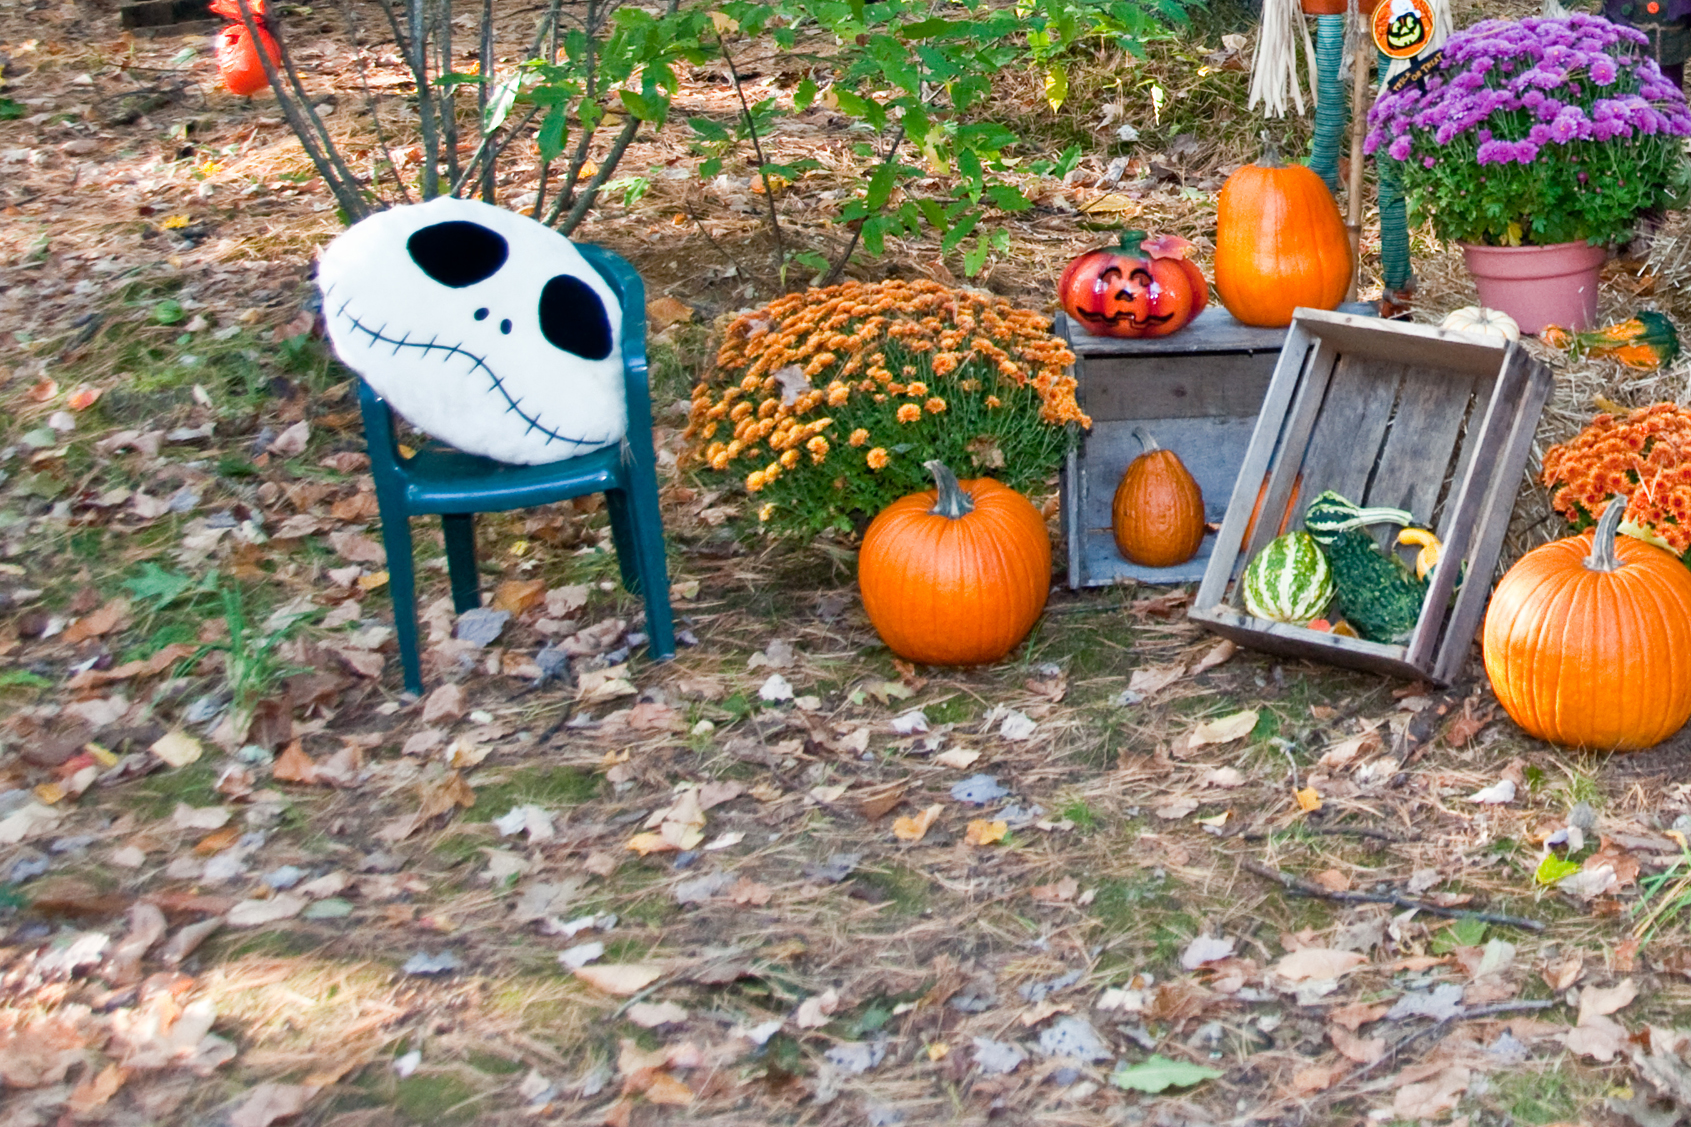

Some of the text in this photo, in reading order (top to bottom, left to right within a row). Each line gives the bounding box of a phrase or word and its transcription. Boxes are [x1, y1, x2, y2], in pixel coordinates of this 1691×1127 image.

[1393, 52, 1443, 91] TRICK OR TREAT
